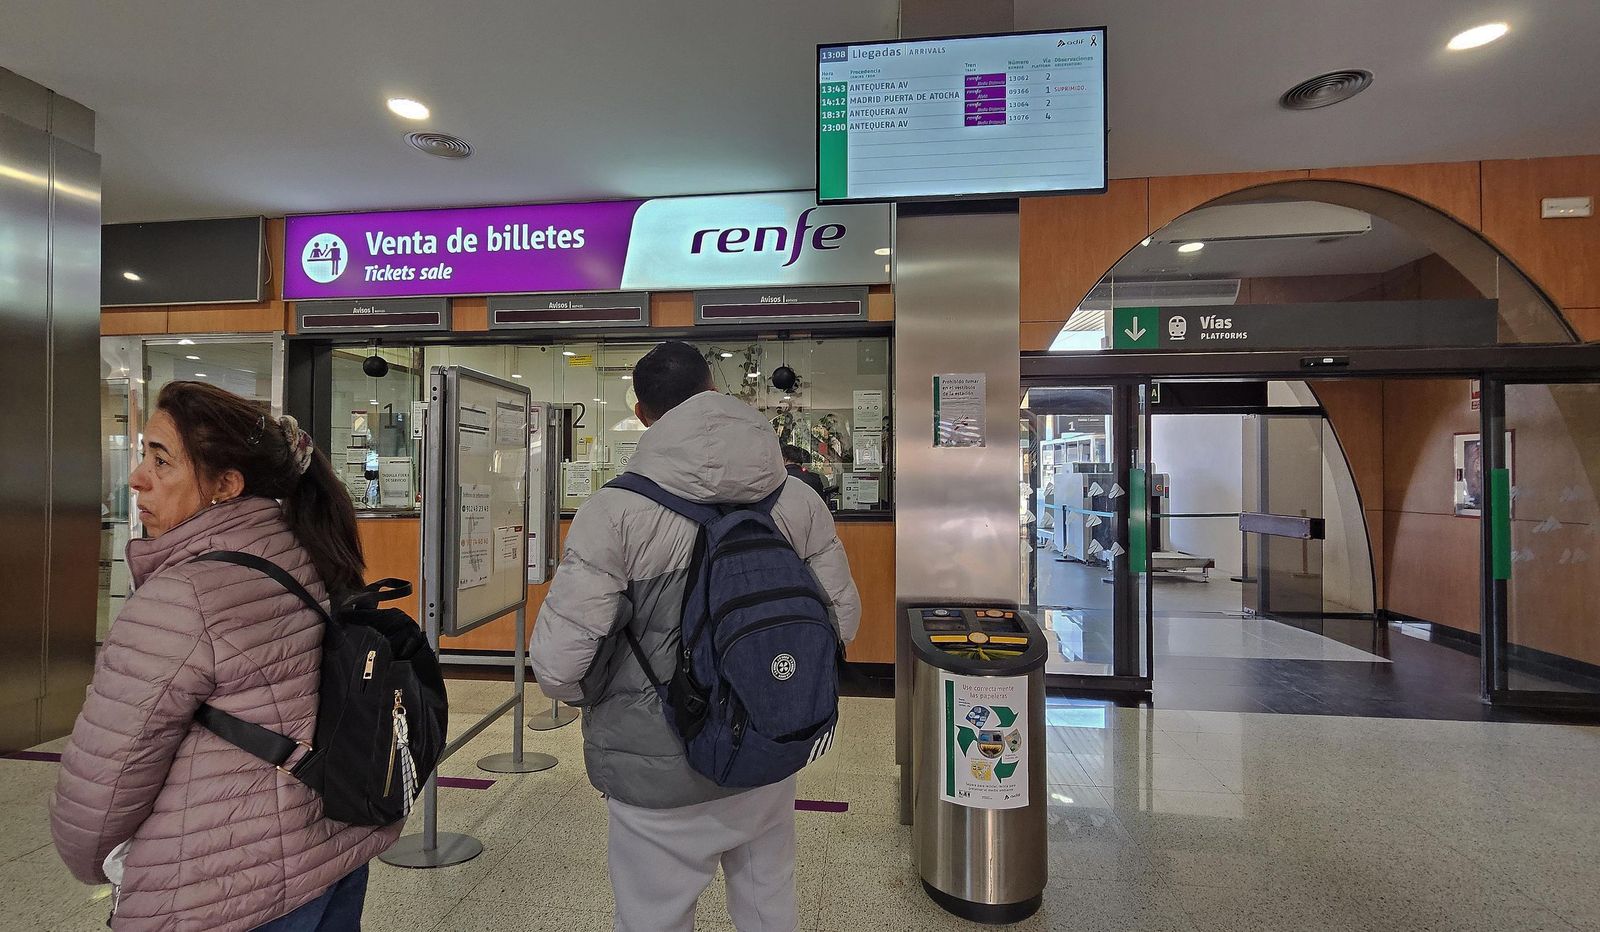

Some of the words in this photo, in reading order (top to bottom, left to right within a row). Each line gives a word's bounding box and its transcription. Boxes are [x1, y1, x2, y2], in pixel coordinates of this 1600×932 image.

[822, 51, 846, 60] 13:08
[852, 47, 902, 60] Llegadas
[909, 47, 946, 56] ARRIVALS
[1045, 73, 1051, 81] 2
[821, 85, 846, 94] 13:43
[849, 84, 896, 92] ANTEQUERA
[897, 81, 909, 89] AV
[821, 98, 846, 107] 14:12
[849, 95, 881, 104] MADRID
[884, 94, 914, 102] PUERTA
[916, 93, 927, 101] DE
[929, 91, 960, 100] ATOCHA
[822, 111, 846, 120] 18:37
[849, 109, 896, 118] ANTEQUERA
[897, 107, 909, 115] AV
[1045, 113, 1052, 121] 4
[822, 124, 846, 133] 23:00
[849, 122, 896, 131] ANTEQUERA
[897, 120, 909, 128] AV
[365, 231, 437, 256] Venta
[446, 227, 478, 253] de
[487, 223, 586, 252] billetes
[690, 207, 847, 267] renfe
[364, 265, 416, 282] Tickets
[419, 262, 453, 280] sale
[760, 295, 781, 303] Avisos
[548, 301, 568, 309] Avisos
[1200, 315, 1233, 329] Vías
[1200, 331, 1248, 340] PLATFORMS
[384, 403, 395, 429] 1
[572, 402, 586, 429] 2
[1068, 421, 1076, 431] 1
